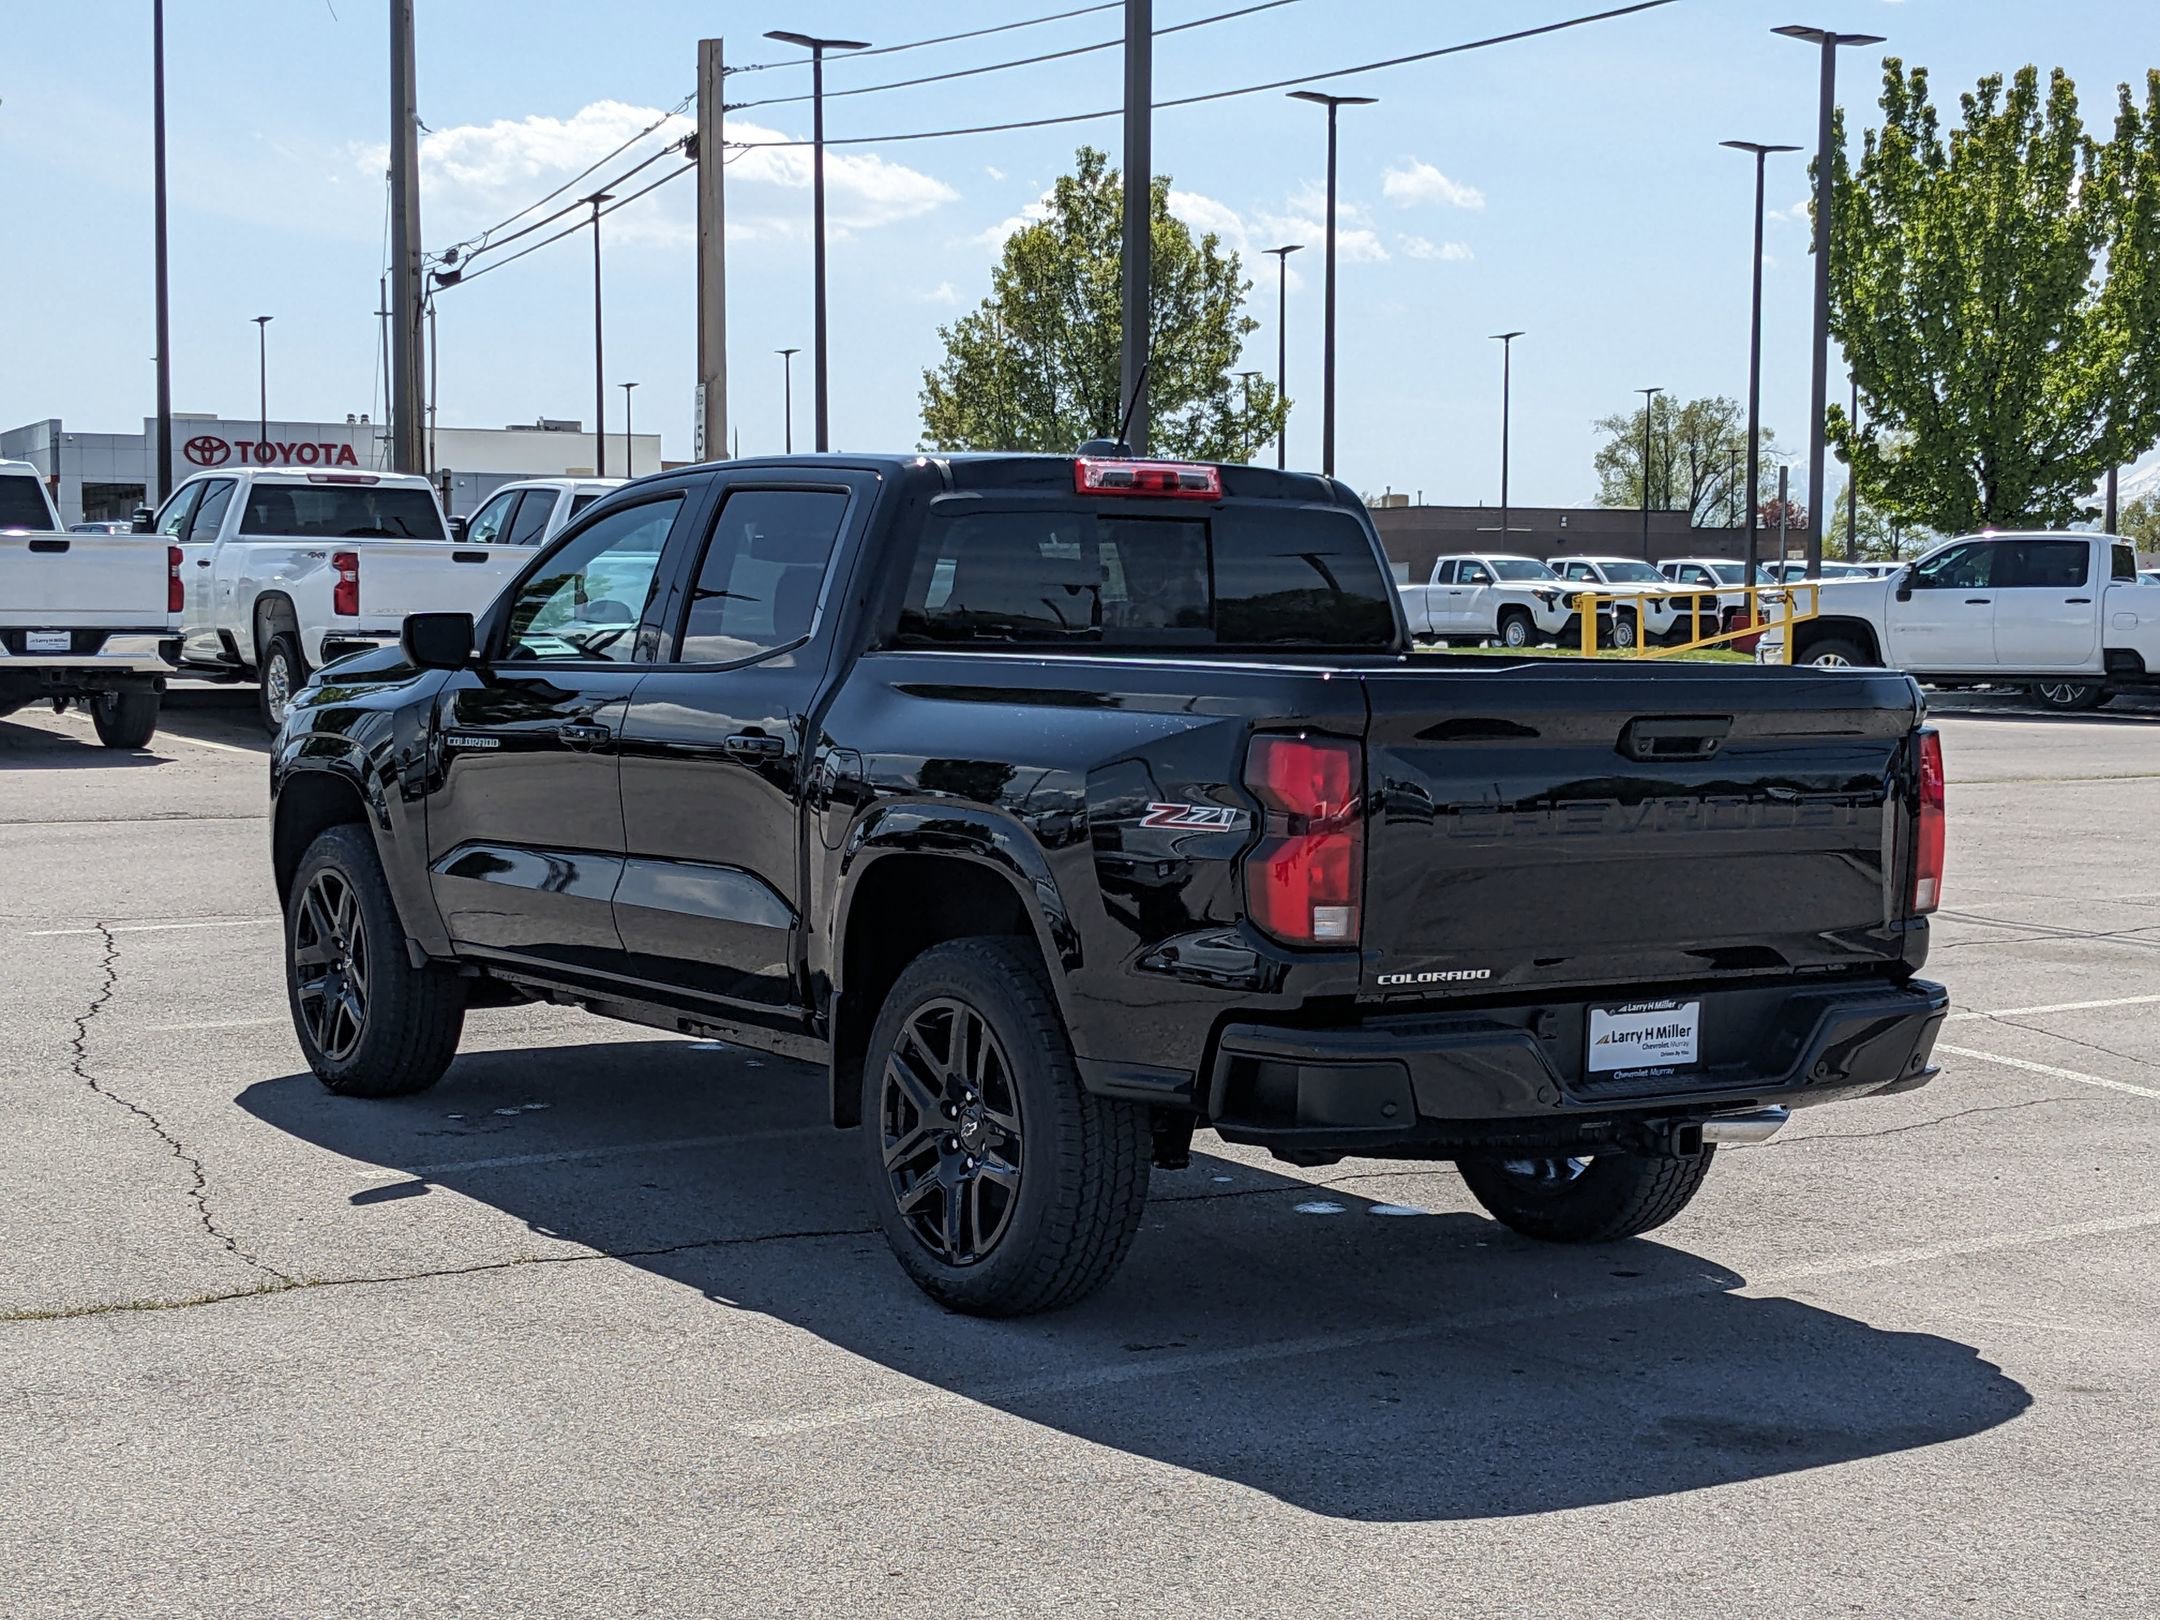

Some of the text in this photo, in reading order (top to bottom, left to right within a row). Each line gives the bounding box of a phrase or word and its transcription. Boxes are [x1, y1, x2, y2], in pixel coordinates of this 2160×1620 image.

[234, 441, 359, 466] TOYOTA
[447, 736, 499, 748] COLORADO
[1139, 802, 1238, 833] Z71
[1447, 790, 1866, 838] CHEVROLET
[1377, 969, 1491, 985] COLORADO
[1627, 1000, 1676, 1012] Larry H Miller
[1611, 1024, 1692, 1044] Larry H Miller
[1642, 1042, 1669, 1050] Chevrolet
[1613, 1067, 1675, 1080] Chevrolet Murray
